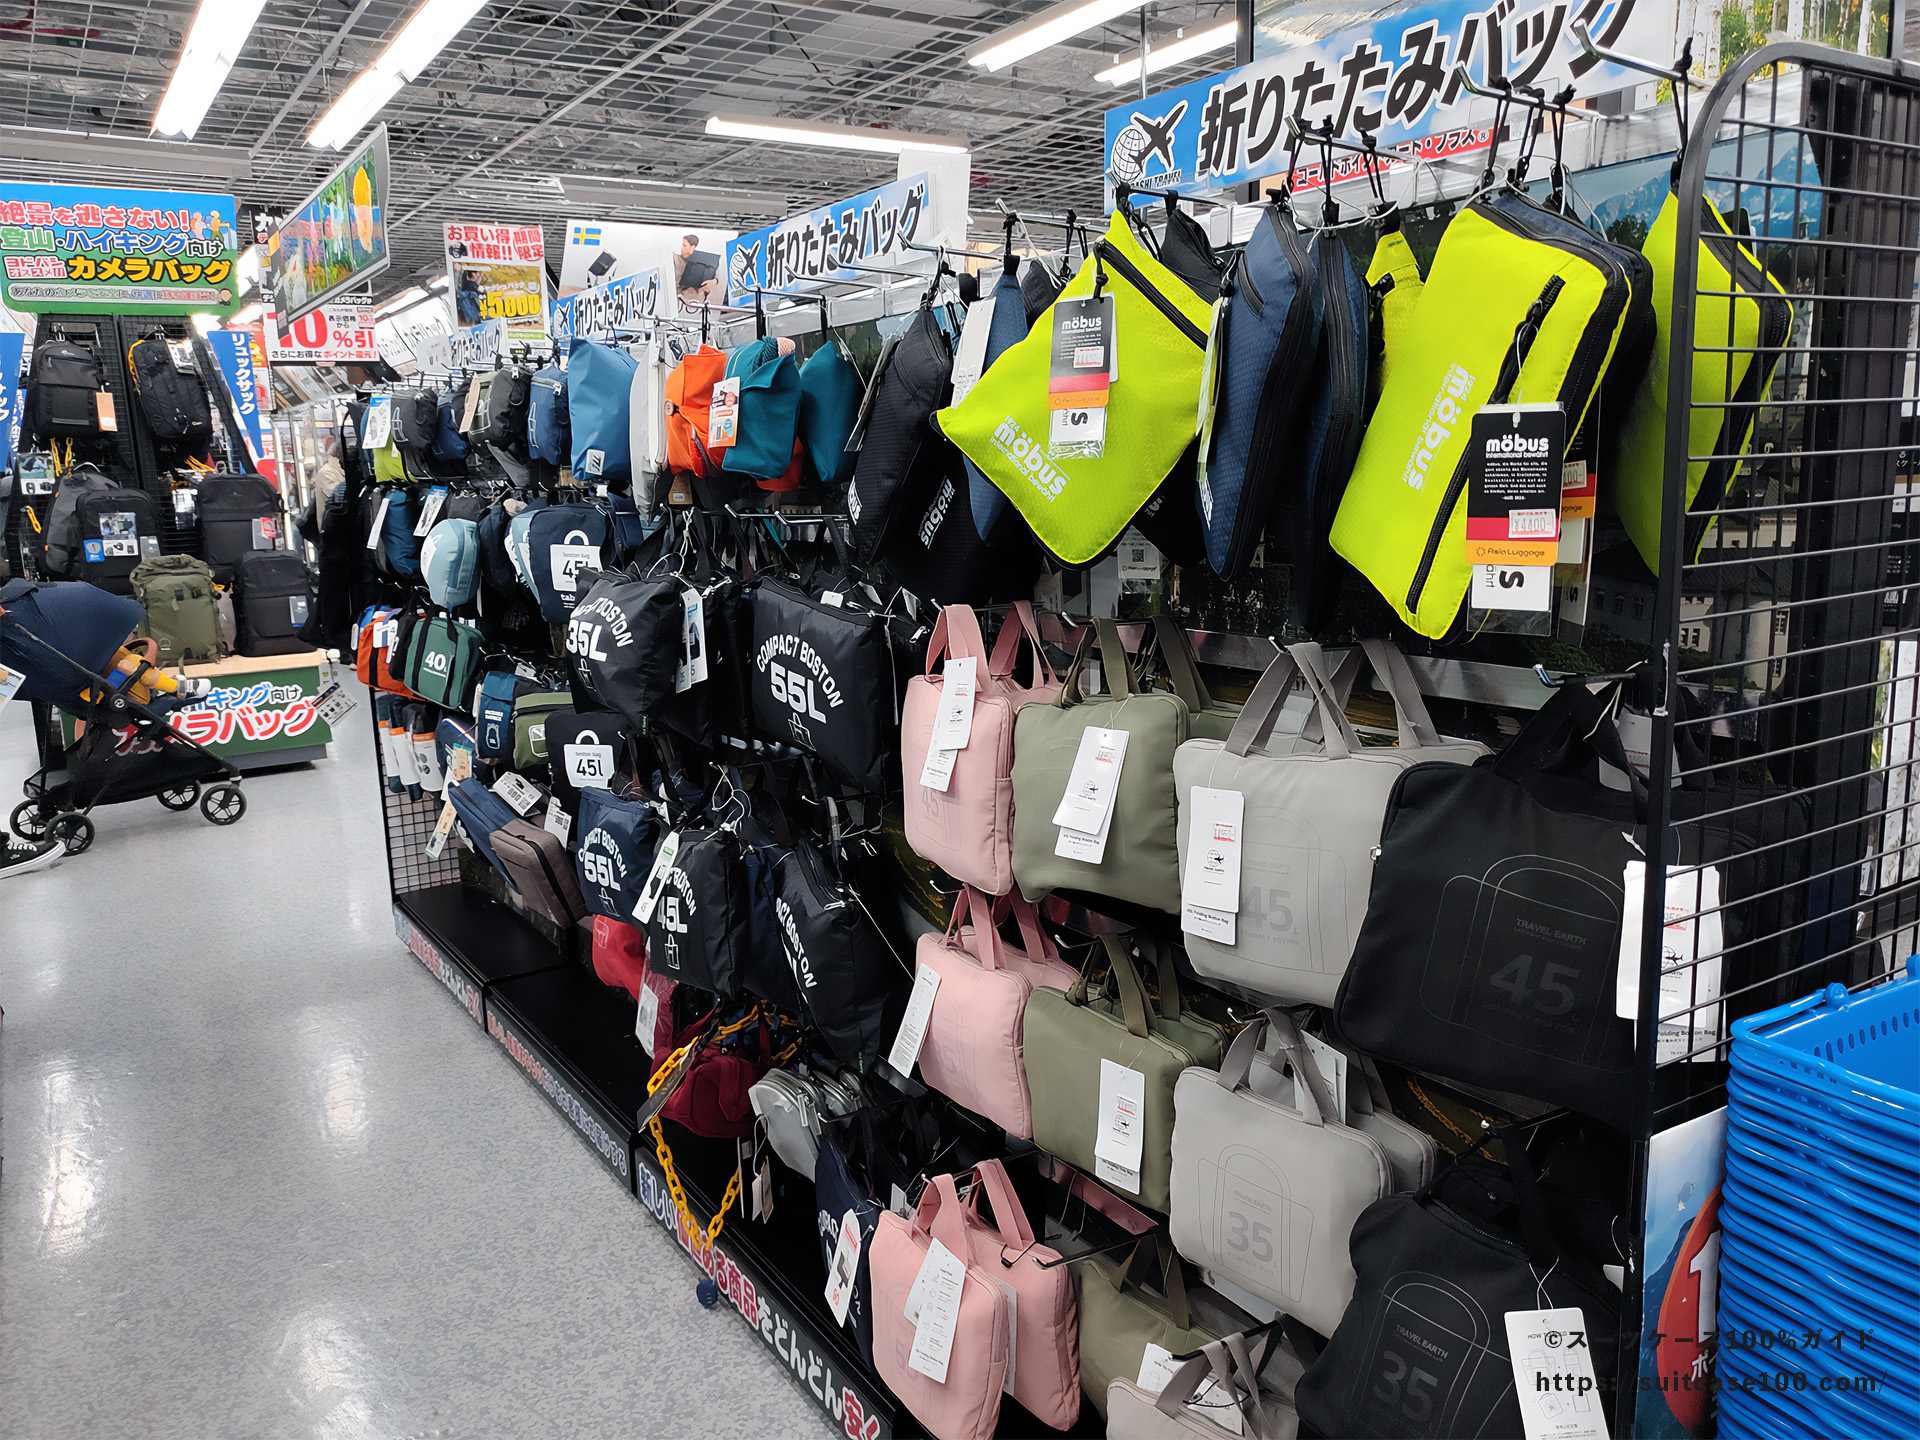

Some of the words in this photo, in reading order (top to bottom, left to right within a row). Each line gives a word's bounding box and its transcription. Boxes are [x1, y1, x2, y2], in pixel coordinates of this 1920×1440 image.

[0, 226, 224, 257] 登山・ハイキング向け
[447, 225, 510, 245] お買い得
[513, 229, 542, 244] 期間
[517, 244, 544, 260] 限定
[766, 178, 926, 290] 折りたたみバッグ
[68, 256, 231, 284] カメラバッグ
[574, 272, 658, 338] 折りたたみバッグ
[1061, 315, 1103, 330] möbus
[231, 332, 255, 415] リュックサック
[1407, 365, 1470, 491] möbus
[1485, 433, 1550, 453] möbus
[994, 422, 1067, 495] möbus
[1499, 569, 1525, 590] S
[565, 619, 608, 662] 35L
[756, 633, 800, 673] COMPACT
[799, 641, 844, 708] BOSTON
[770, 661, 827, 724] 55L
[584, 850, 622, 892] 55L
[601, 830, 628, 878] BOSTON
[656, 895, 688, 934] 45L
[1240, 886, 1293, 933] 45
[1515, 918, 1552, 936] TRAVEL
[1553, 930, 1587, 945] EARTH
[1489, 953, 1580, 1016] 45
[1703, 1029, 1716, 1037] Bag
[1226, 1211, 1274, 1263] 35
[1396, 1324, 1422, 1345] TRAVEL
[1421, 1339, 1449, 1359] EARTH
[1372, 1350, 1439, 1423] 35
